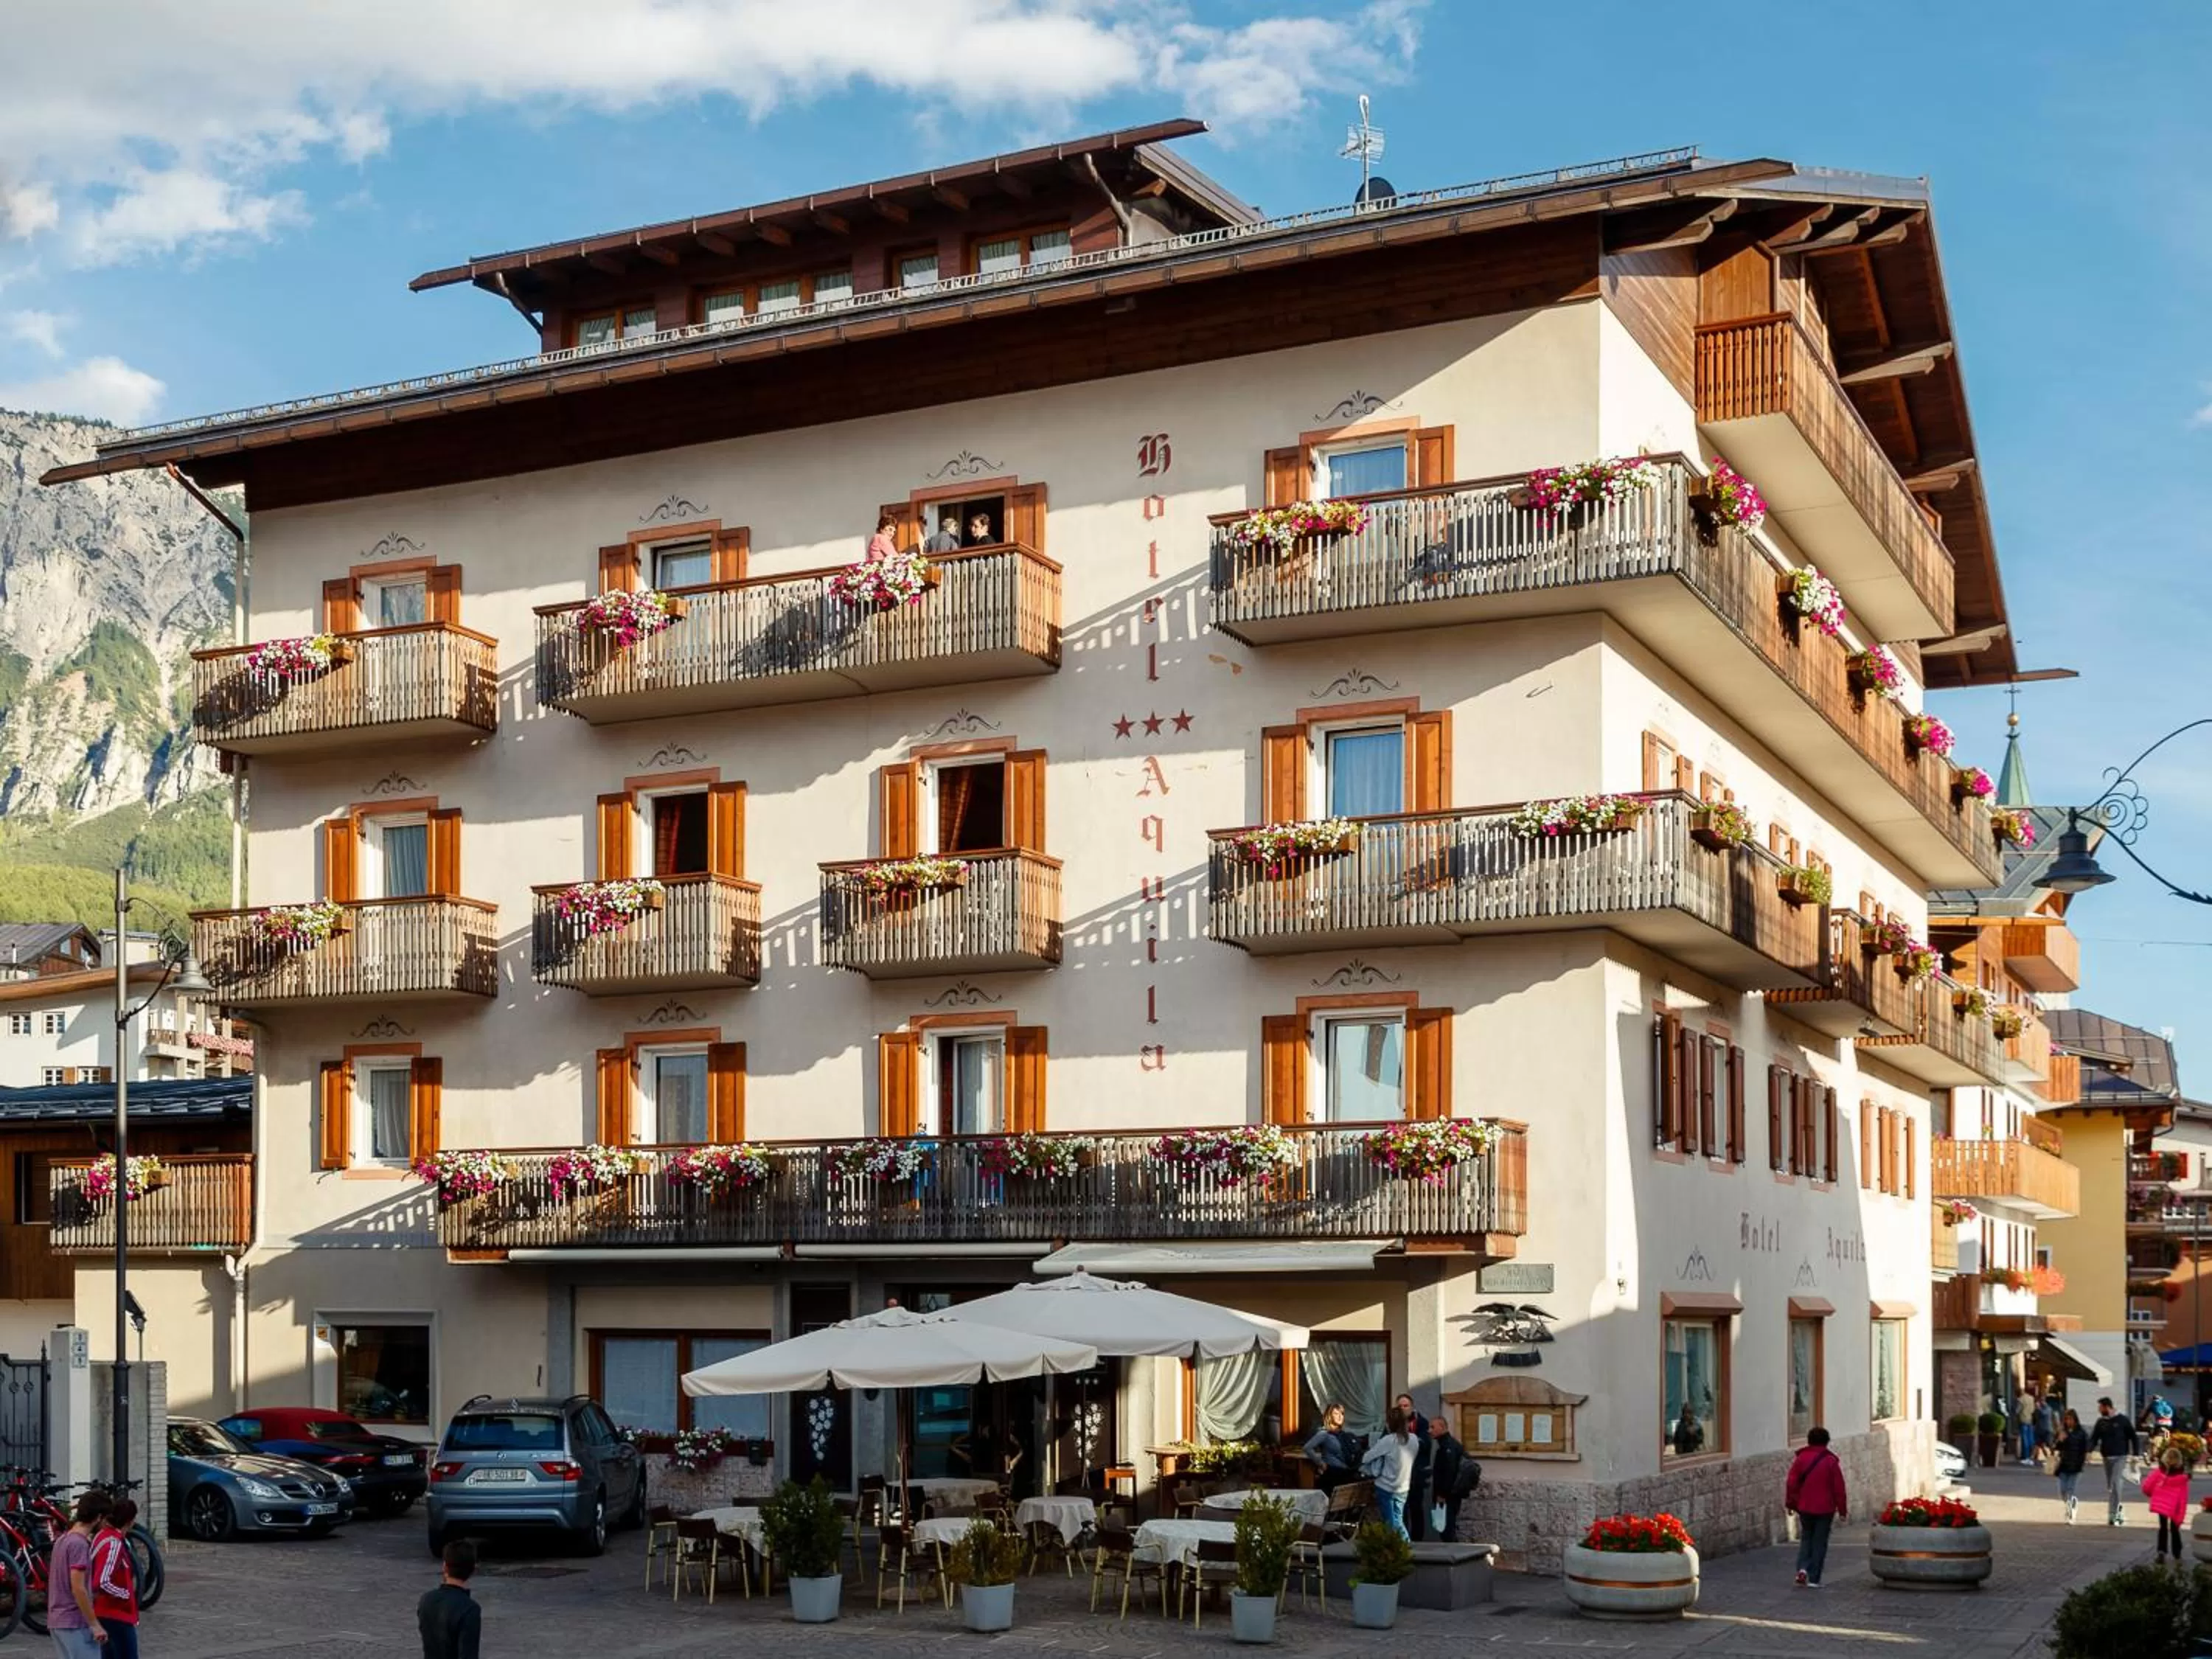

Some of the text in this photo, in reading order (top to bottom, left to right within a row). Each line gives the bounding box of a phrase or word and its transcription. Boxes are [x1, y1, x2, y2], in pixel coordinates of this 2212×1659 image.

[1136, 433, 1173, 1071] Hotel Aquila
[1741, 1212, 1866, 1270] Hotel Aquila
